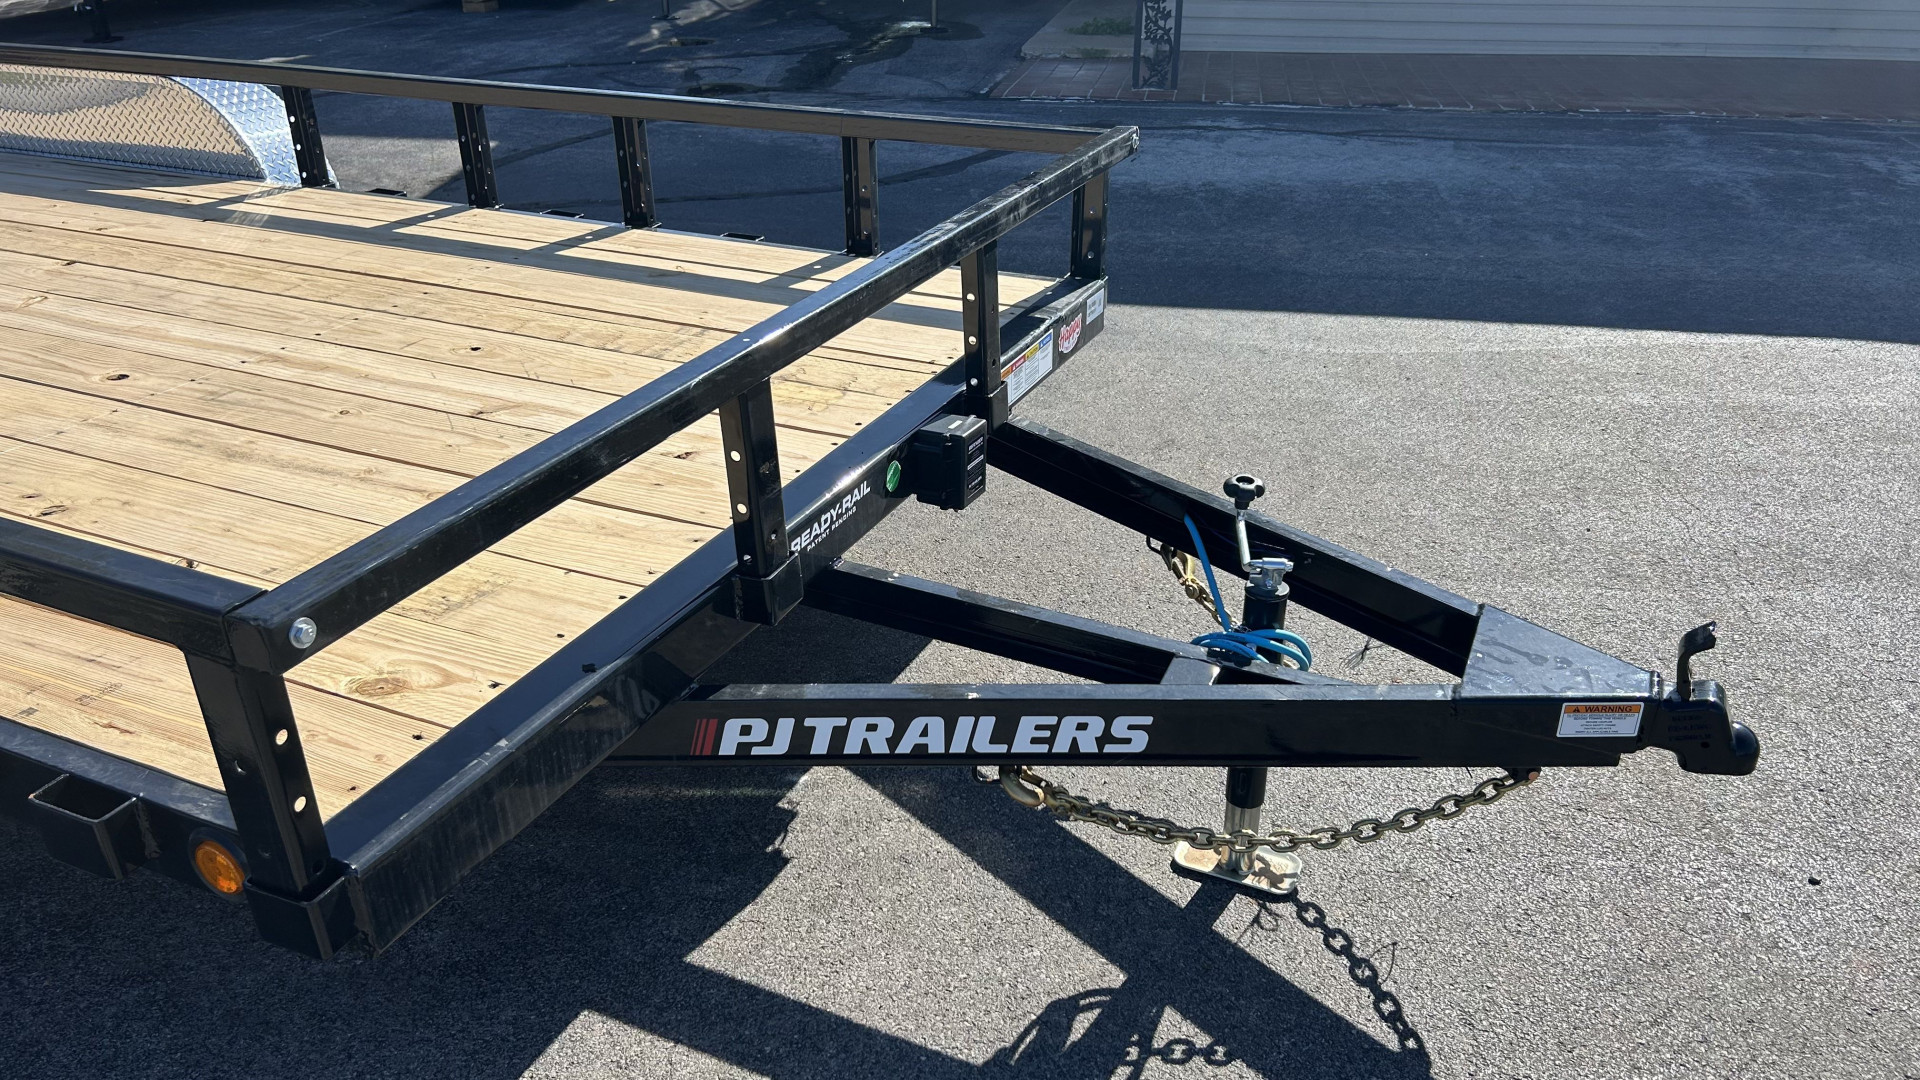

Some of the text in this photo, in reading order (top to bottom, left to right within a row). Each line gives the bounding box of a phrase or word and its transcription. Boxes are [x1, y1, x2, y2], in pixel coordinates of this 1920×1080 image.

[806, 505, 857, 552] PATENT PENDING
[1584, 705, 1633, 713] WARNING
[718, 715, 1155, 756] PJ TRAILERS
